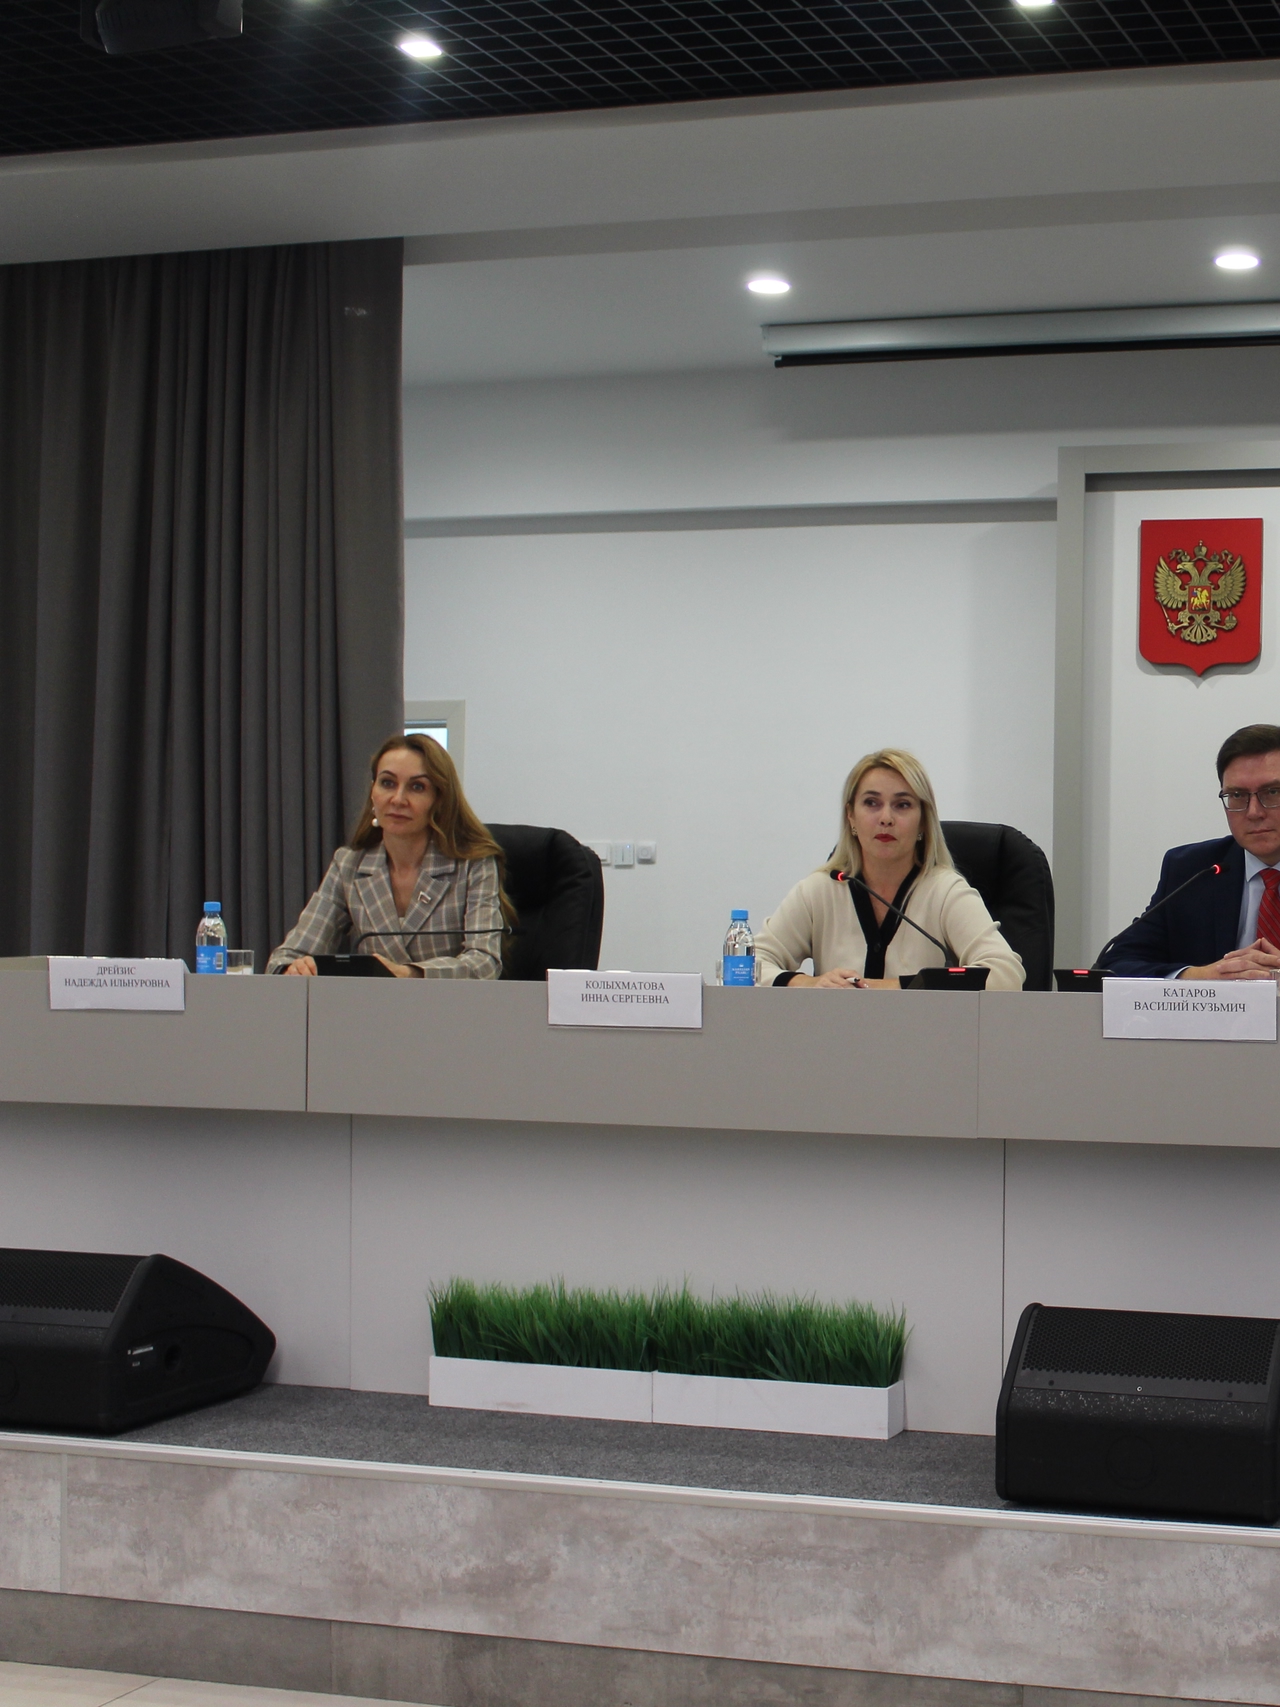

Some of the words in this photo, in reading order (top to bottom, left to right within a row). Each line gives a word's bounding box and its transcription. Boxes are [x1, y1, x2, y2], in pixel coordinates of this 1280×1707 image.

[97, 965, 136, 976] ДРЕЙЗИС
[64, 978, 108, 988] НАДЕЖДА
[110, 979, 170, 988] ИЛЬНУРОВНА
[585, 980, 665, 991] КОЛЫХМАТОВА
[581, 993, 610, 1003] ИННА
[612, 994, 669, 1004] СЕРГЕЕВНА
[1163, 988, 1216, 998] КАТАРОВ
[1134, 1000, 1189, 1012] ВАСИЛИЙ
[1192, 1003, 1246, 1013] КУЗЬМИЧ
